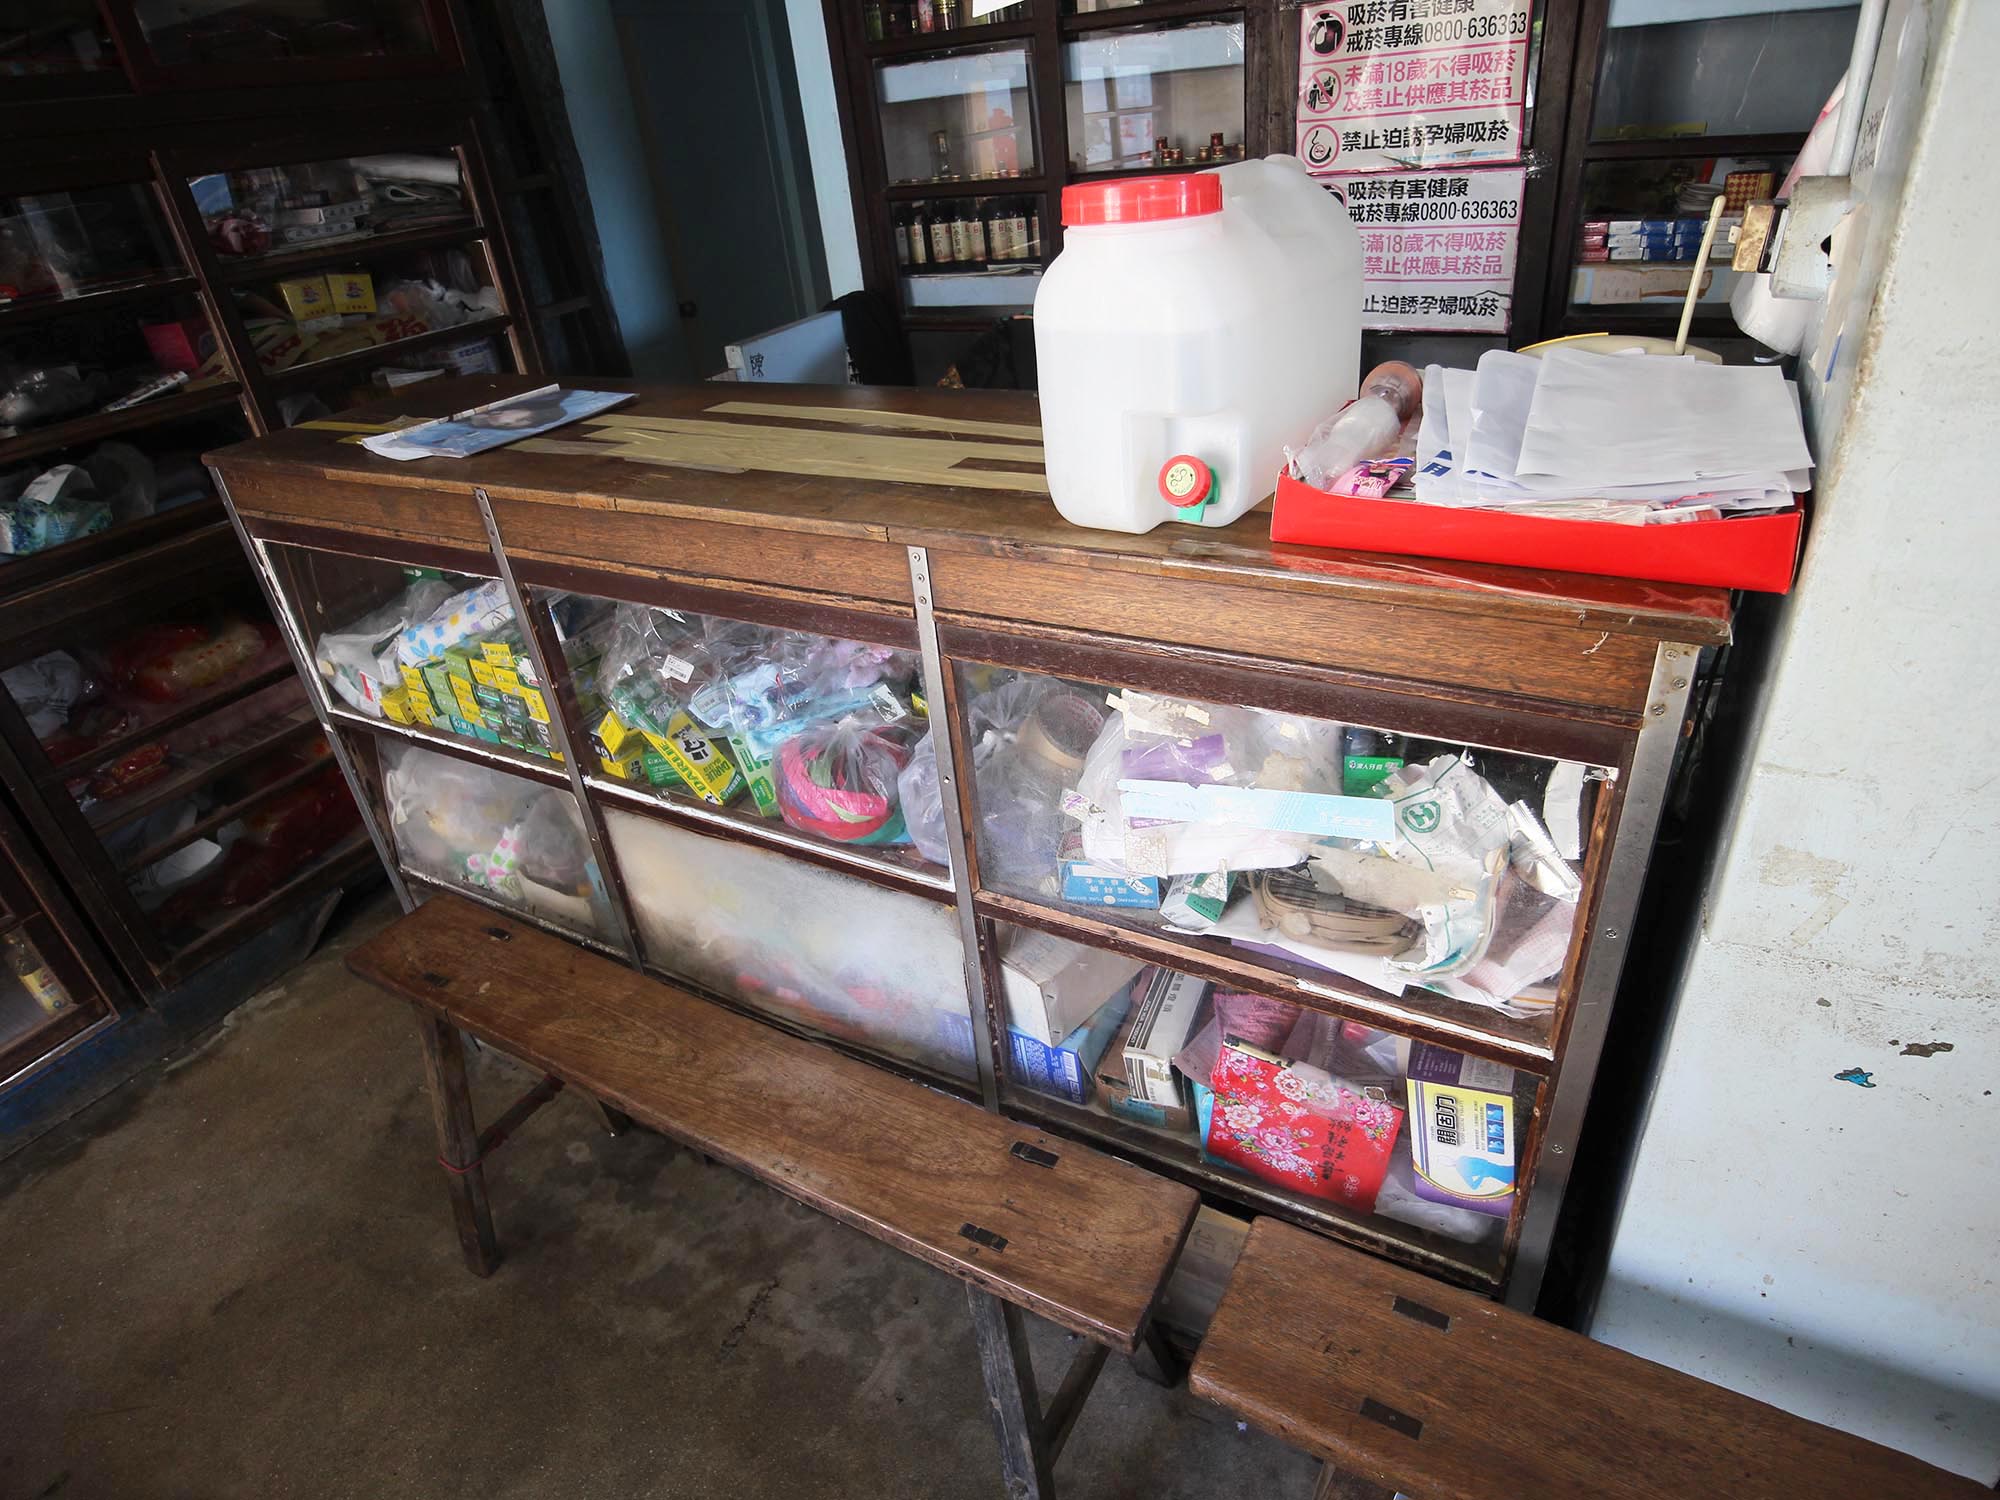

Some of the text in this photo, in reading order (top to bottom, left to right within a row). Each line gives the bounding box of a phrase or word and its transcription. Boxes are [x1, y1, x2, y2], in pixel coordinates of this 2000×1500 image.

[1347, 0, 1475, 26] 吸菸有害健康
[1346, 12, 1527, 53] 戒菸專線0800-636363
[1344, 49, 1516, 87] 未滿18歲不得吸菸
[1343, 76, 1512, 112] 及禁止供應其菸品
[1342, 119, 1509, 152] 禁止迫誘孕婦吸菸
[1348, 178, 1469, 200] 吸菸有害健康
[1348, 200, 1517, 223] 戒菸專線0800-636363
